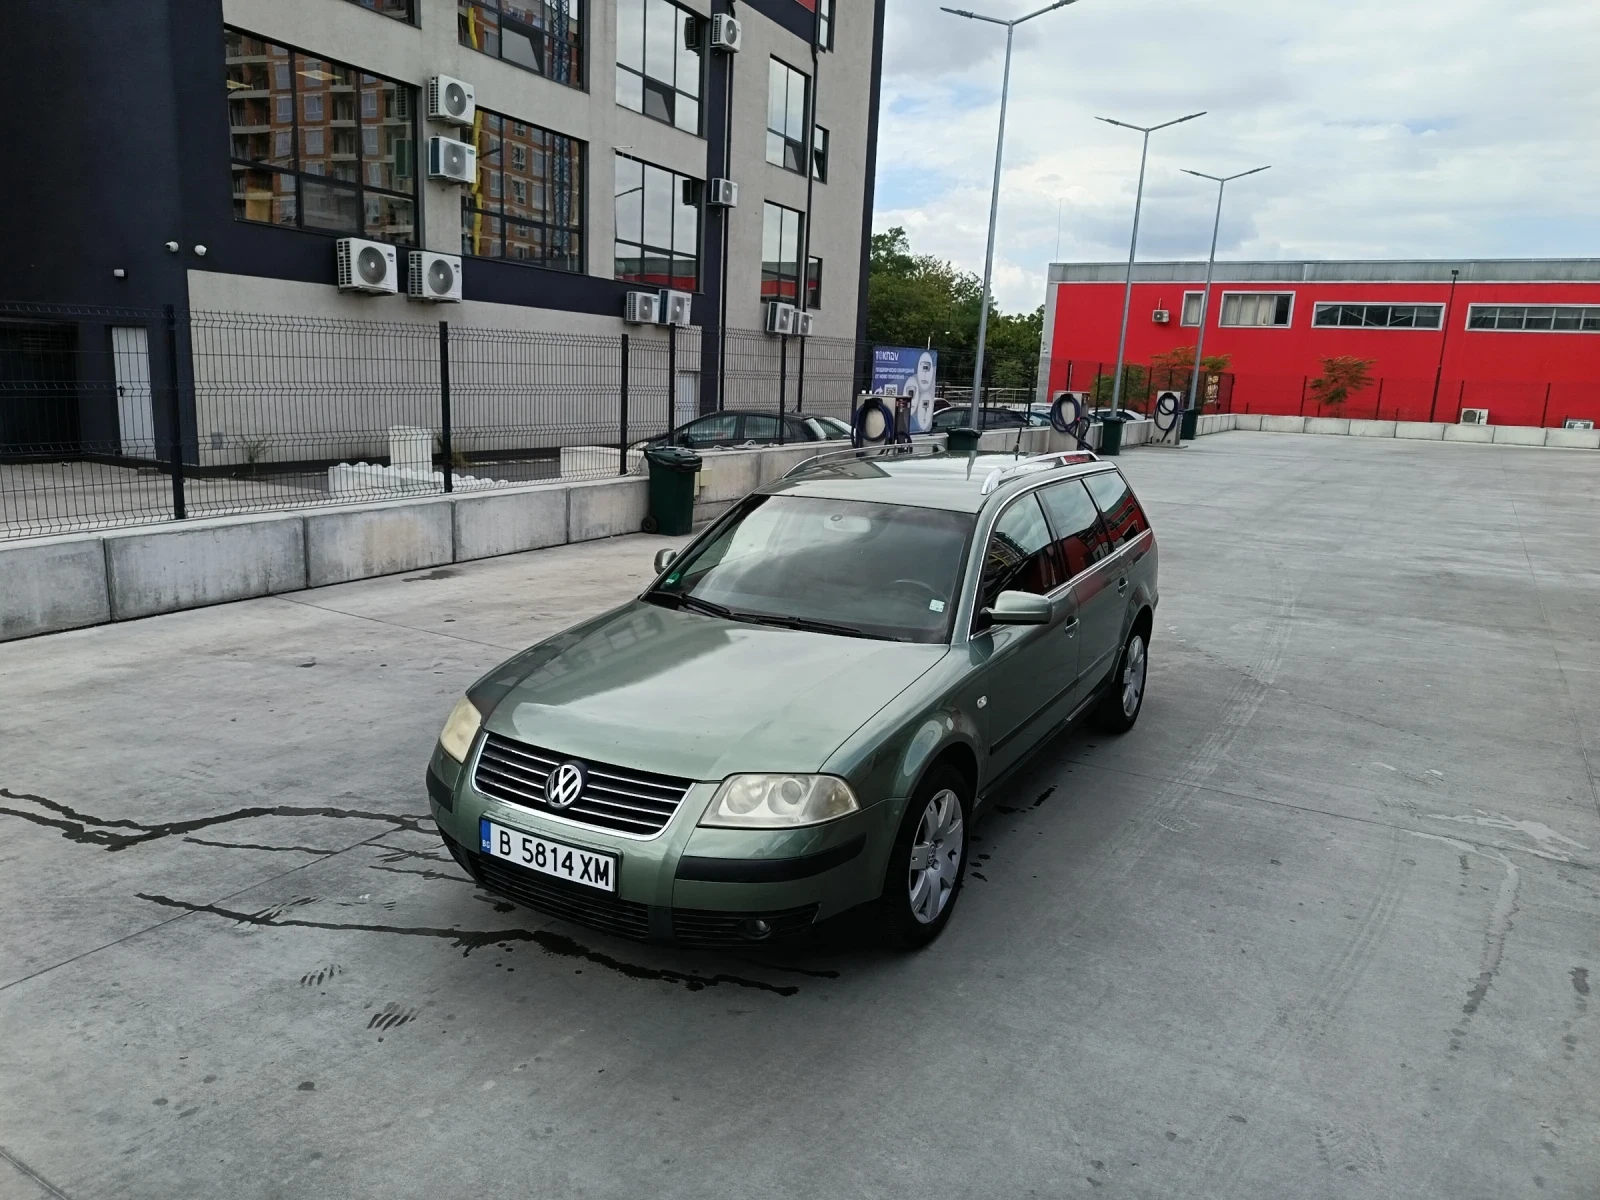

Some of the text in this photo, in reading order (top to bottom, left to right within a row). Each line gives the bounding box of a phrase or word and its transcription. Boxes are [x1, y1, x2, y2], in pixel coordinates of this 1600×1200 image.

[499, 830, 609, 887] B 5814 XM
